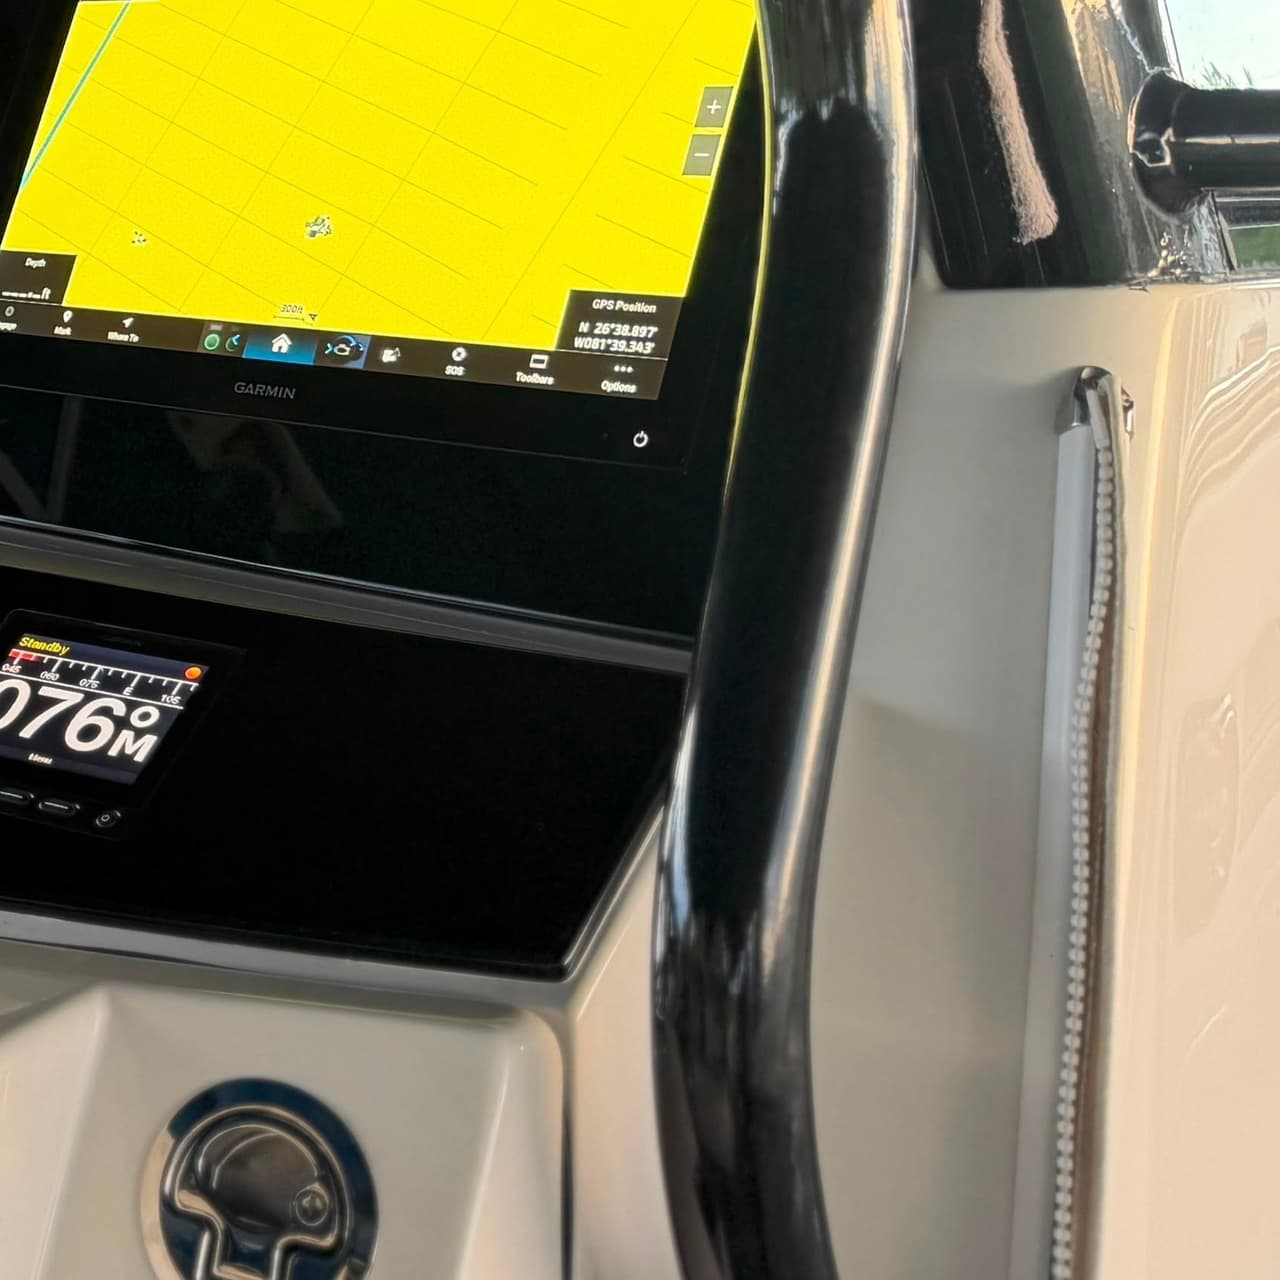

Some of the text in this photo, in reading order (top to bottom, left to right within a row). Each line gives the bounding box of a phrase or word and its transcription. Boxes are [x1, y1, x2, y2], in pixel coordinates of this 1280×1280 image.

[592, 299, 657, 314] GPS Position
[578, 321, 590, 333] N
[444, 365, 465, 376] SOS
[515, 371, 555, 385] Toolbars
[234, 382, 296, 399] GARMIN
[600, 380, 638, 394] Options
[18, 636, 71, 656] Standby
[39, 671, 60, 681] 060
[79, 678, 100, 689] 075
[123, 687, 134, 696] E
[161, 694, 182, 705] 105
[28, 752, 53, 765] Menu
